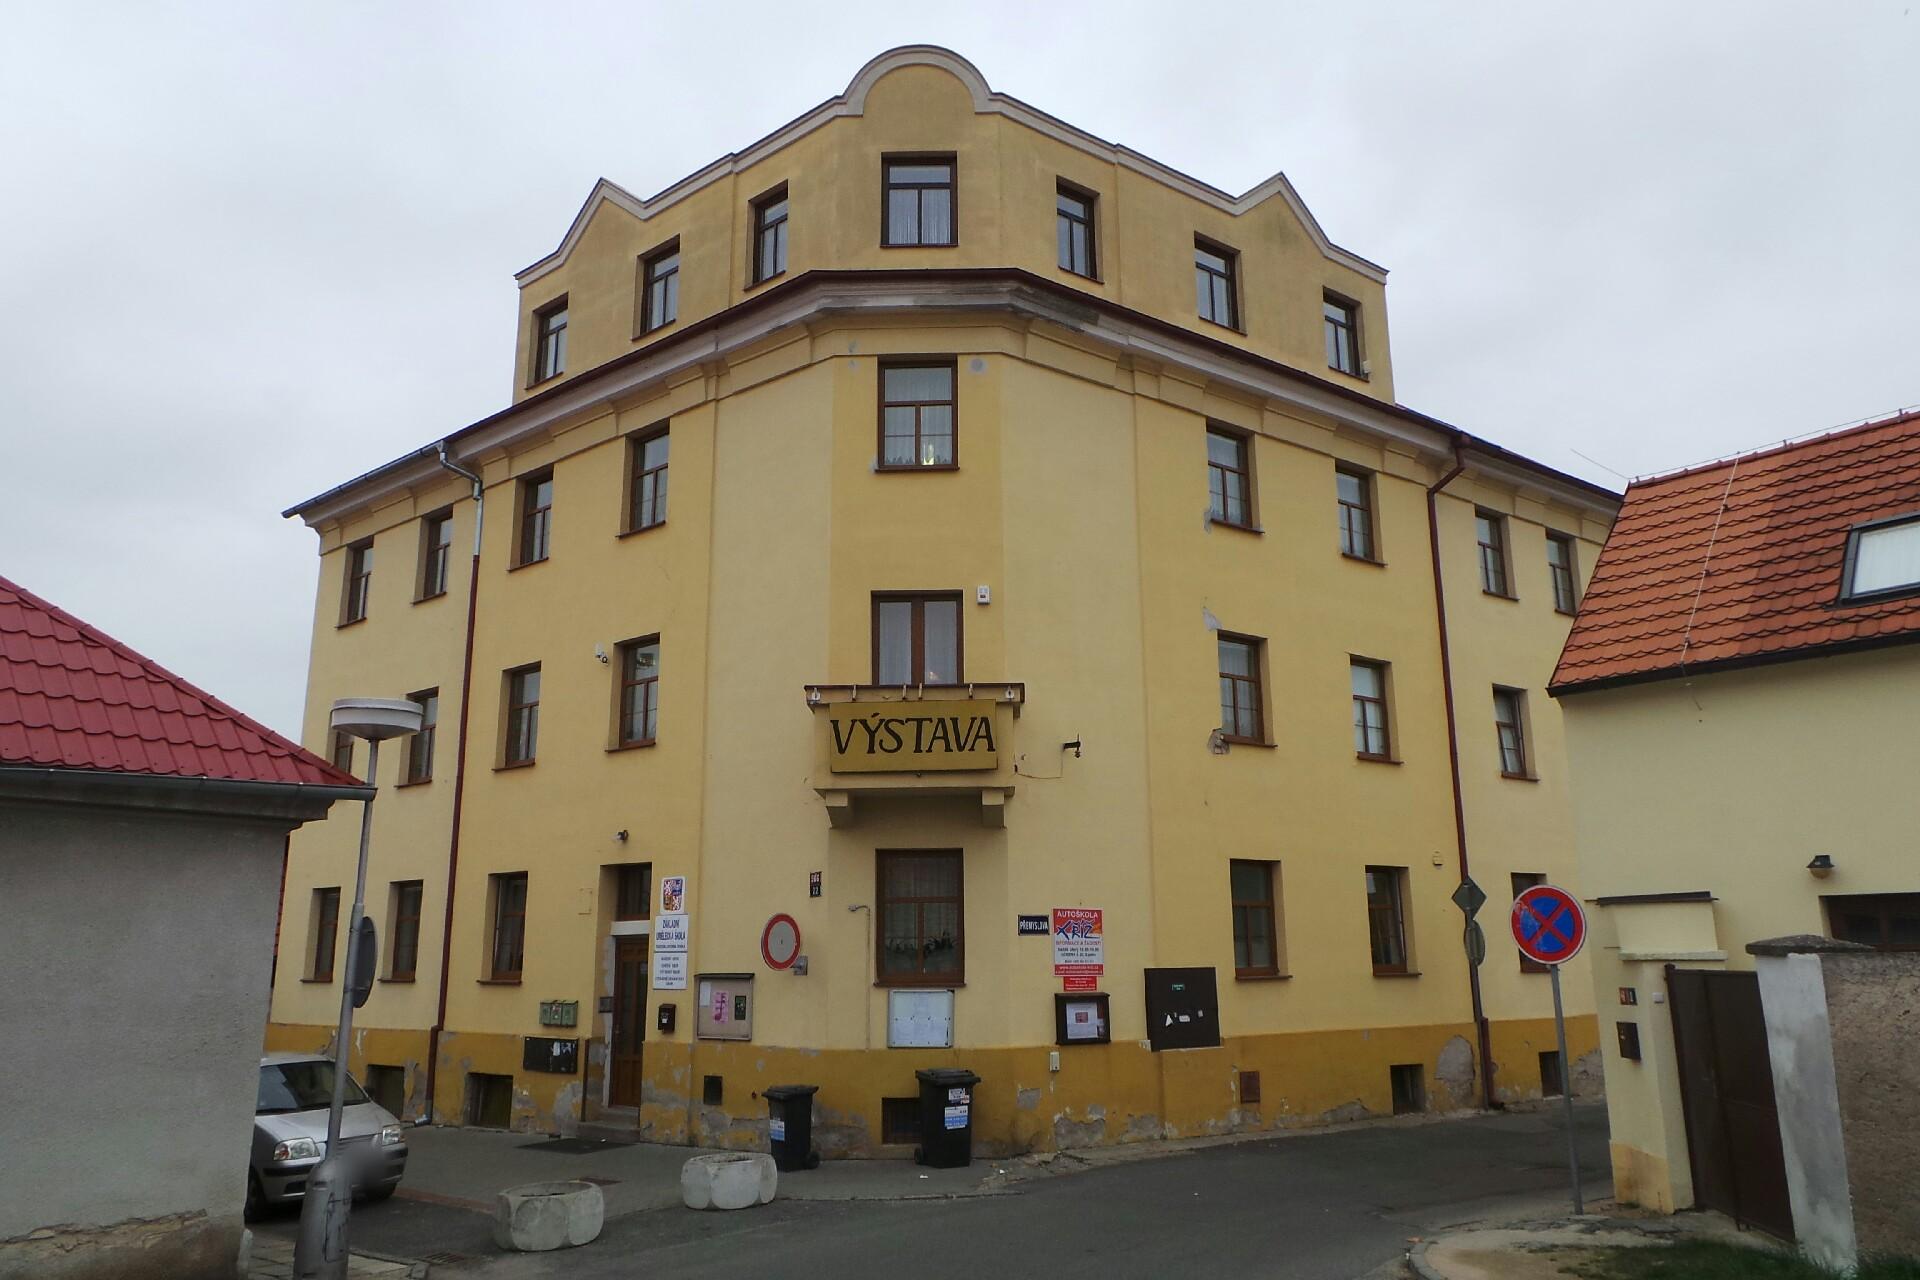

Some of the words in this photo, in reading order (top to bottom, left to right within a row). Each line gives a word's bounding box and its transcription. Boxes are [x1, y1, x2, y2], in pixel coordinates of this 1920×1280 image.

[830, 712, 996, 754] VÝSTAVA
[1057, 910, 1098, 918] AUTOŠKOLA
[1020, 919, 1049, 930] PŘEMYSLOVA
